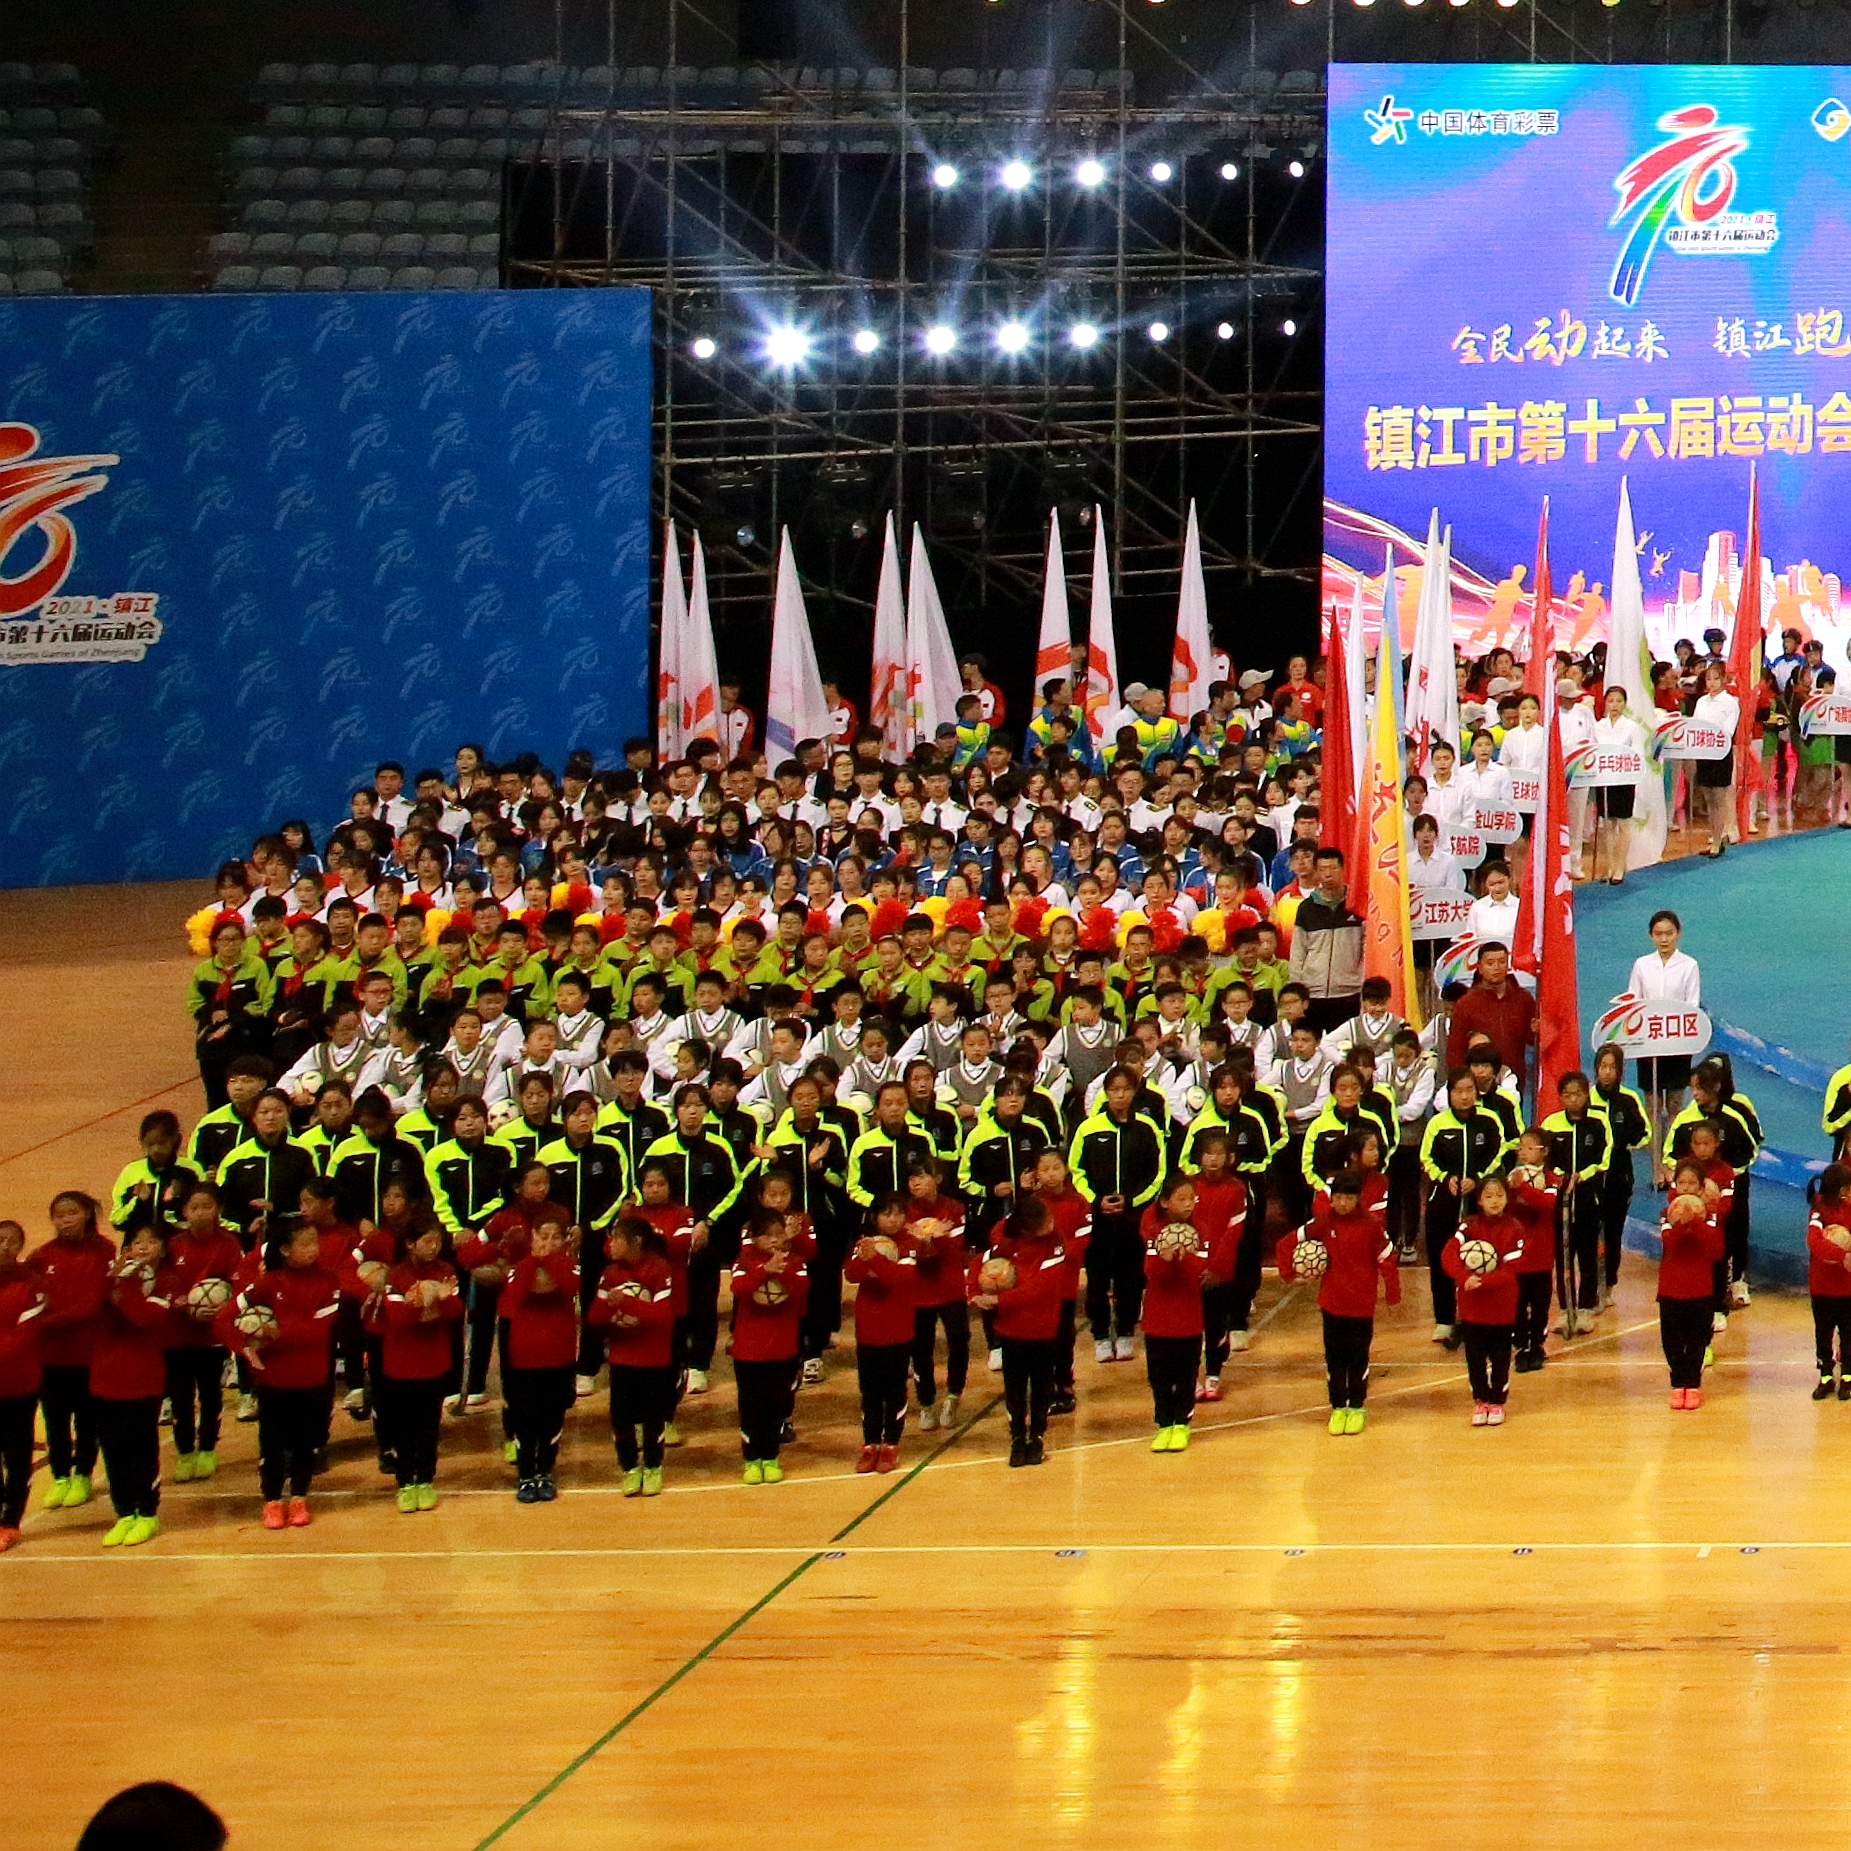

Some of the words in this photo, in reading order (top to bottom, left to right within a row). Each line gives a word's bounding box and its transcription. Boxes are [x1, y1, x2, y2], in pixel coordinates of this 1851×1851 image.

[1421, 111, 1557, 133] 中国体育彩票
[1451, 308, 1671, 366] 全民动起来
[1686, 730, 1726, 747] 门球协会
[1647, 1012, 1699, 1041] 京口区
